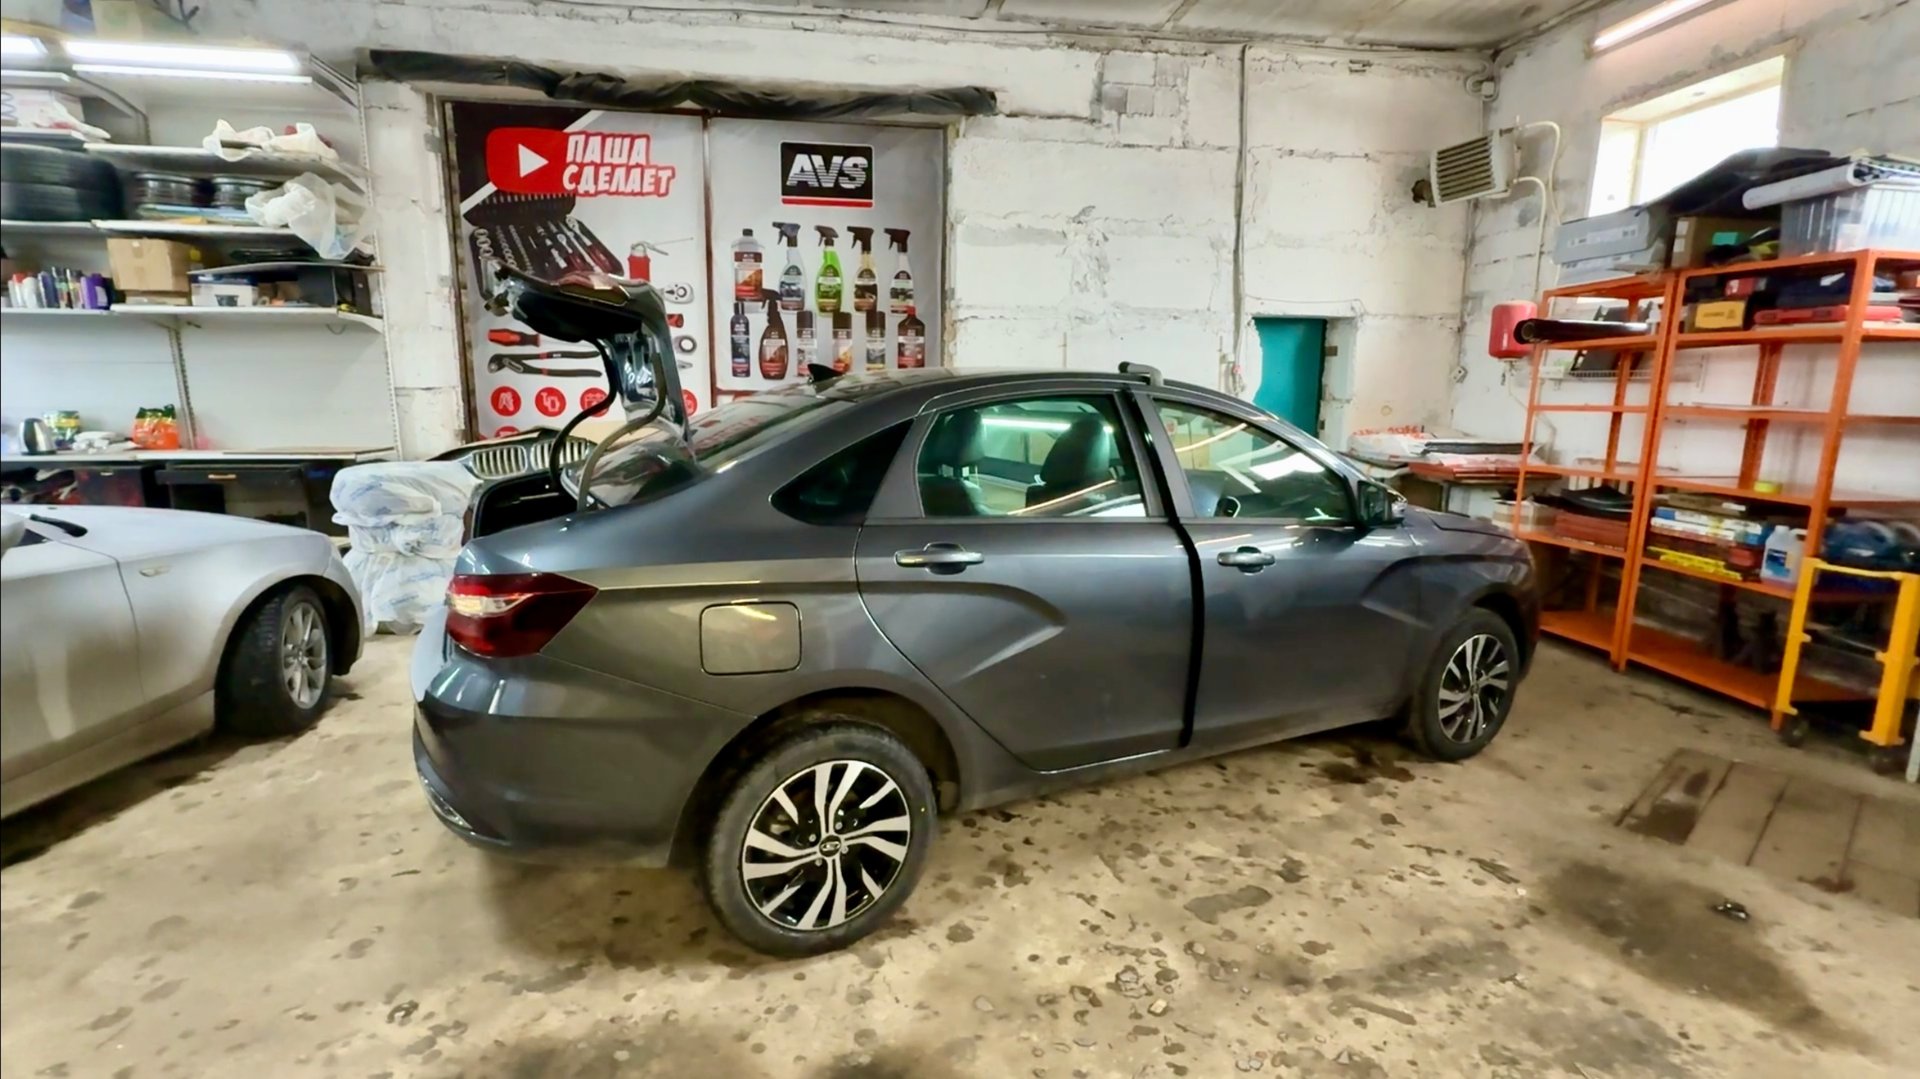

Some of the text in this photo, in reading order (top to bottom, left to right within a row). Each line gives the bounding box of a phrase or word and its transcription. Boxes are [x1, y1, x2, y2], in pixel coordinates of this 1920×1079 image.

[565, 133, 648, 165] ПАША
[562, 163, 674, 195] СДЕЛАЕТ
[785, 153, 869, 189] AVS
